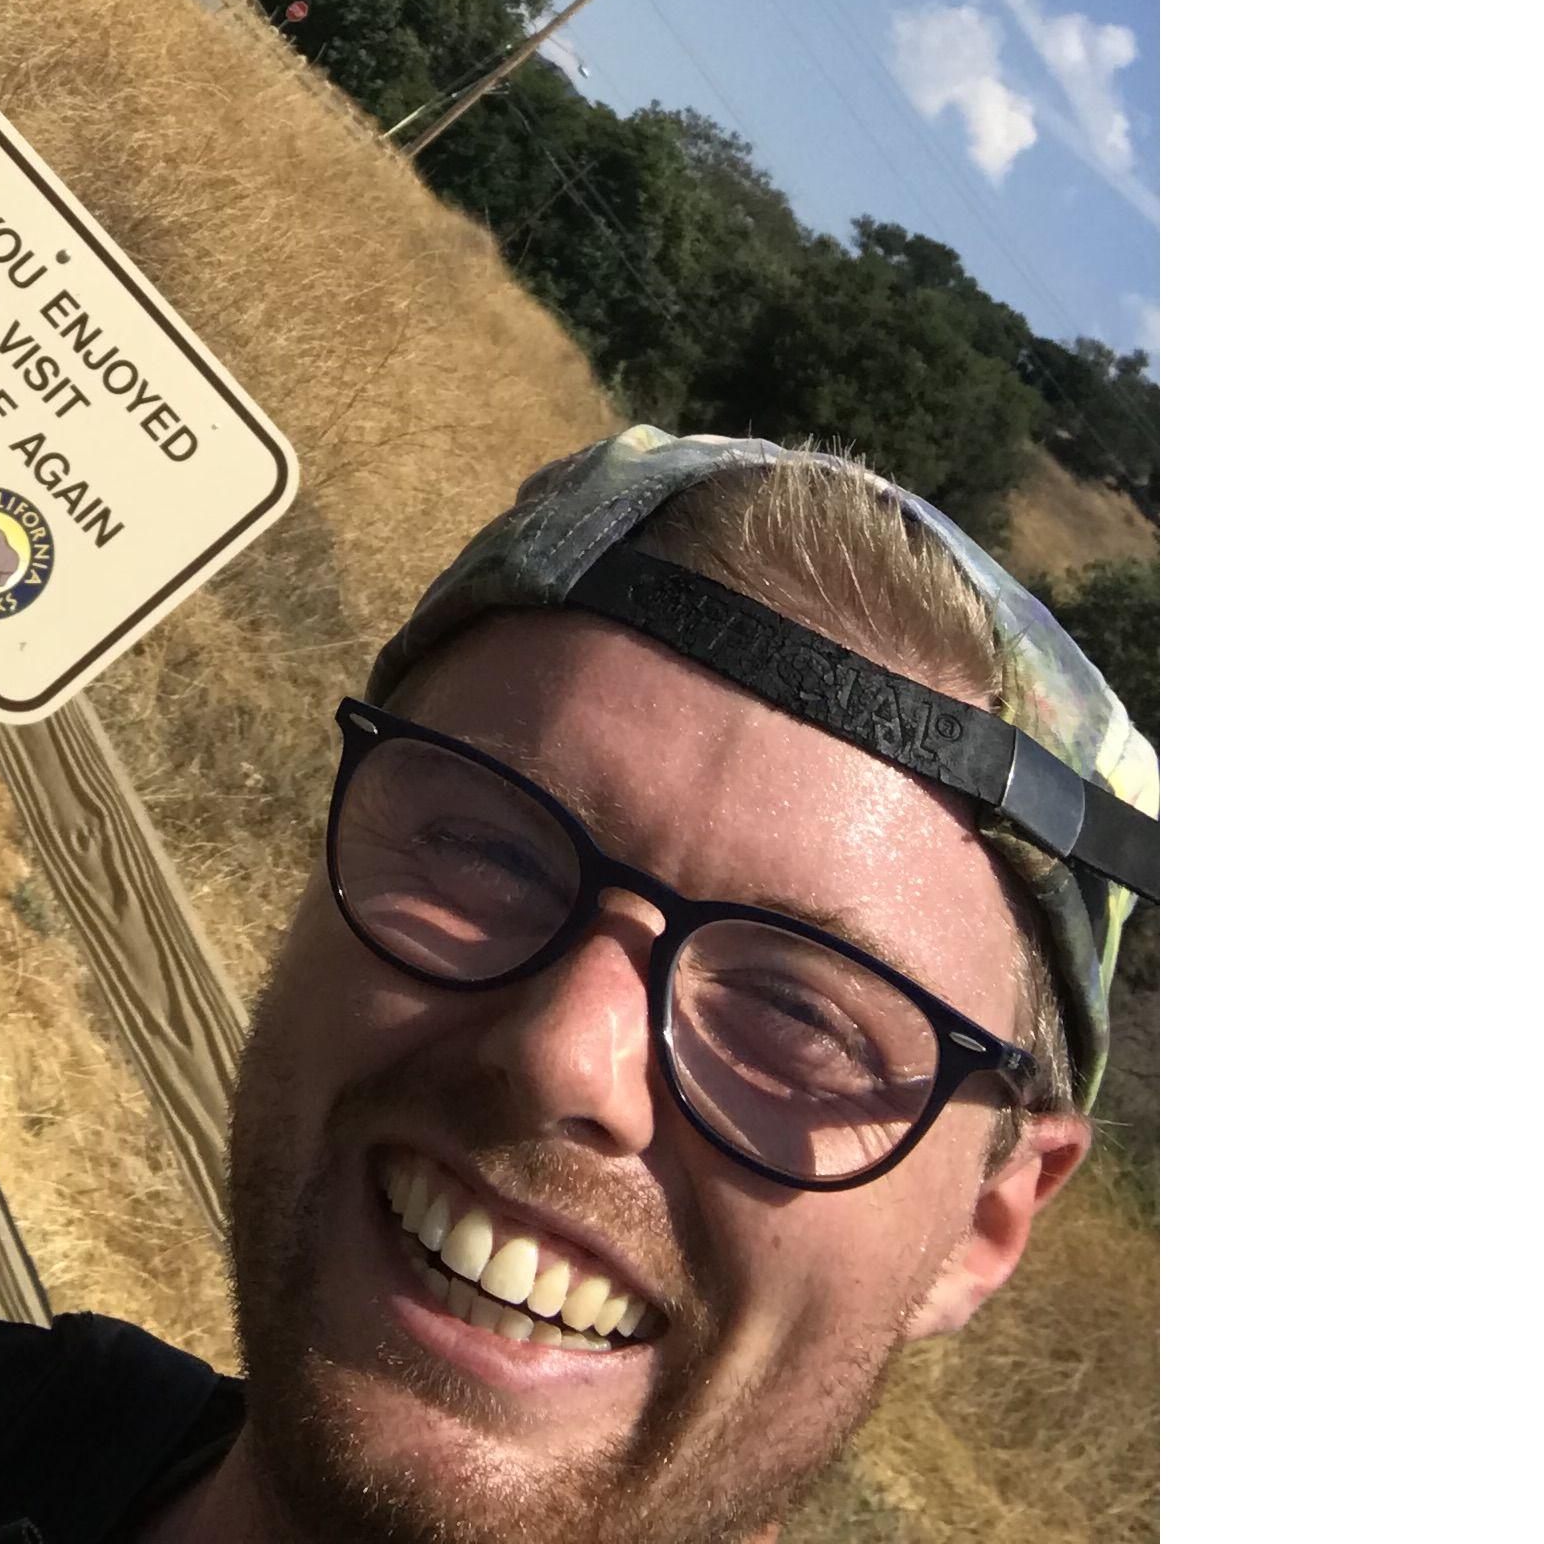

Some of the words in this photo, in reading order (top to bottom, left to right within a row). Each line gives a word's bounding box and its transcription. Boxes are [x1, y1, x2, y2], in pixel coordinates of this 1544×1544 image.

[0, 320, 90, 417] VISIT
[40, 290, 197, 461] ENJOYED
[9, 433, 124, 548] AGAIN
